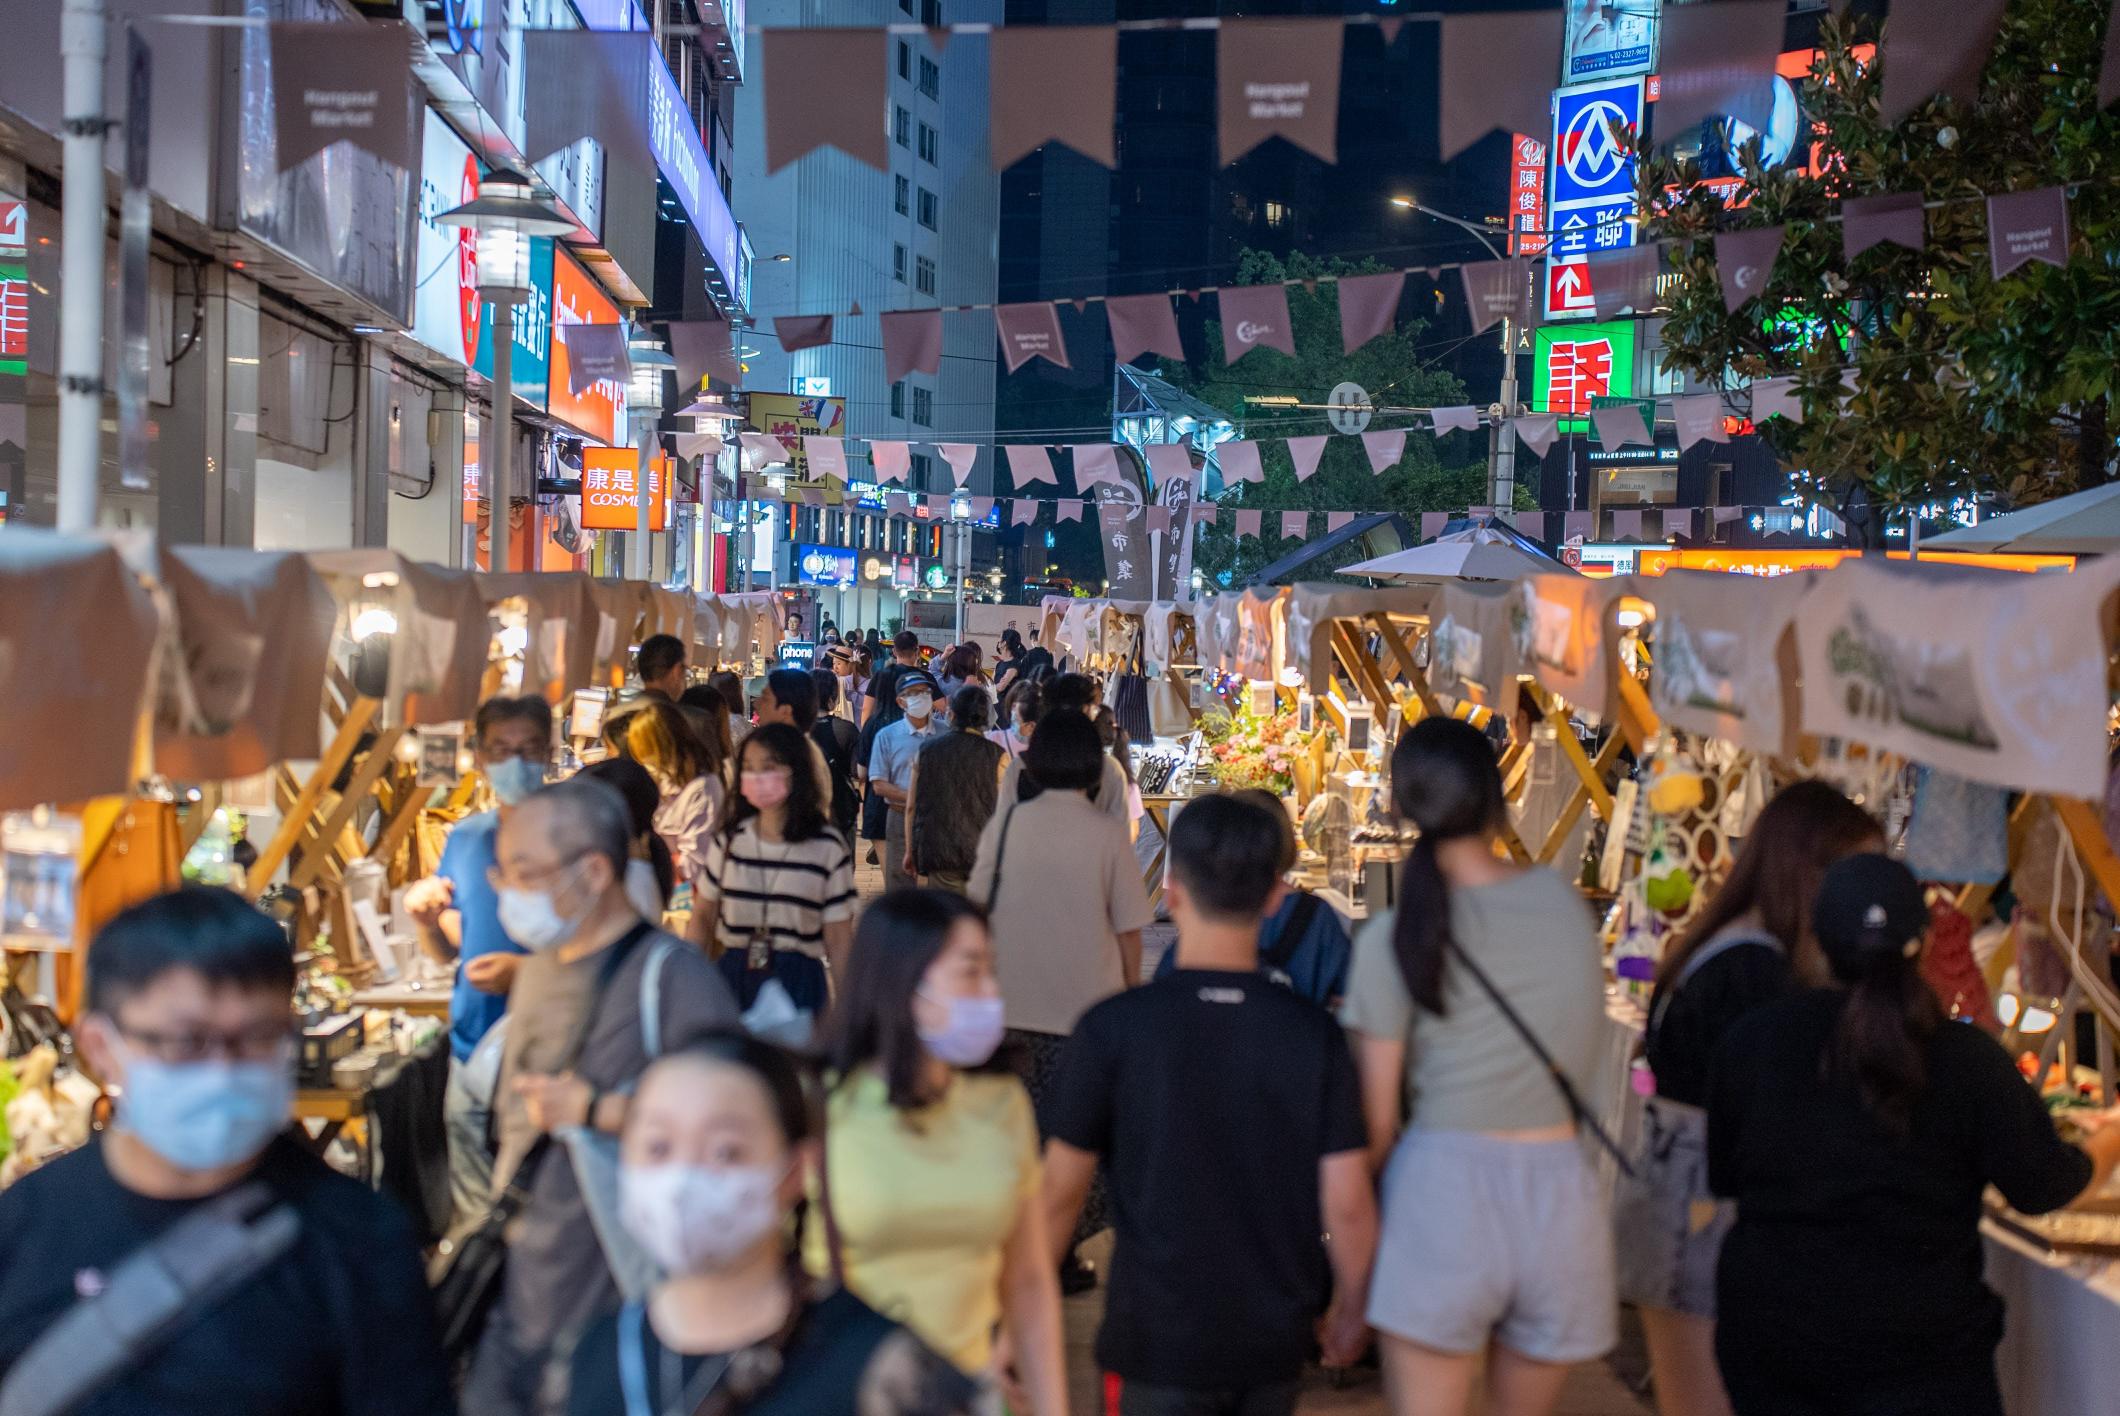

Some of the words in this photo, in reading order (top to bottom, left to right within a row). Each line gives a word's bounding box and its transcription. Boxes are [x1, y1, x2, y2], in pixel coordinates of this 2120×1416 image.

[1249, 102, 1304, 118] Market
[1561, 208, 1623, 251] 全聯
[2006, 228, 2052, 241] Hangout
[2011, 240, 2049, 253] Market
